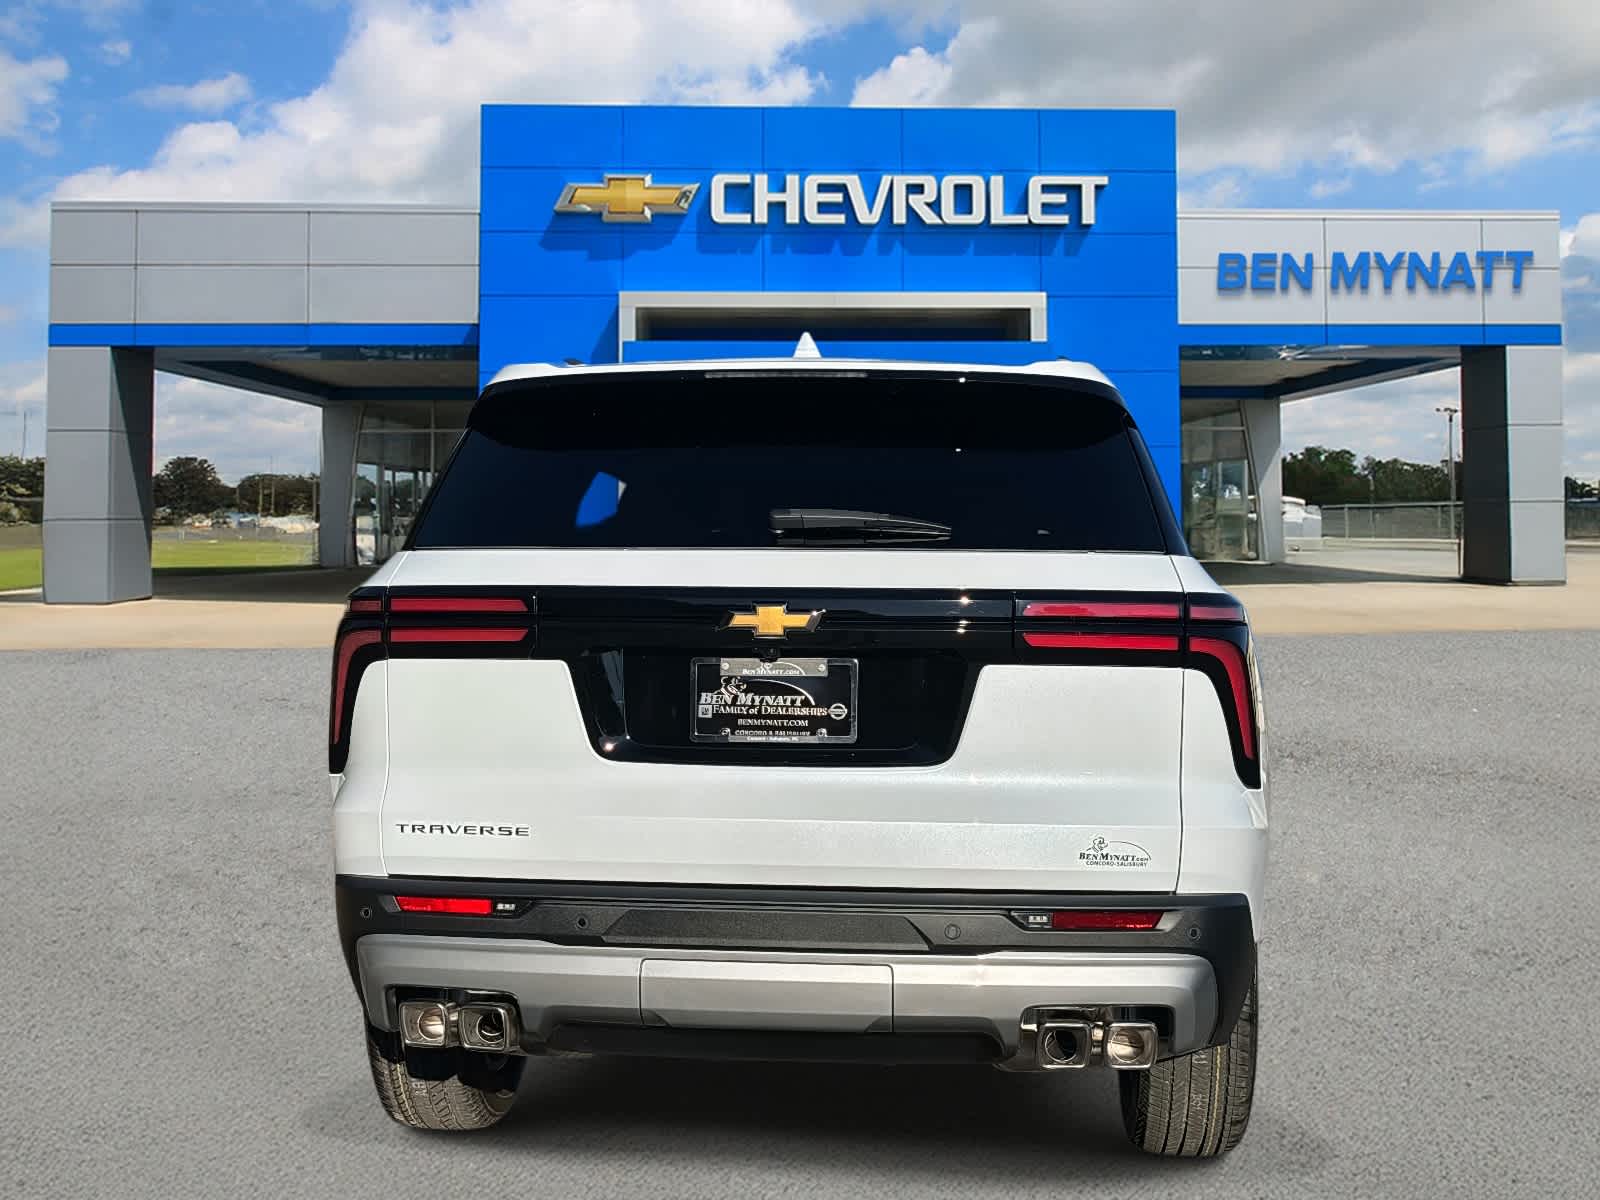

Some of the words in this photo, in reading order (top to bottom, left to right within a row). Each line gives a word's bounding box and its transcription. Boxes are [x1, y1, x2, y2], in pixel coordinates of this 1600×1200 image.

[711, 173, 1109, 225] CHEVROLET
[1217, 252, 1313, 290] BEN
[1330, 251, 1534, 290] MYNATT
[700, 692, 733, 704] BEN
[736, 693, 805, 706] MYNATT
[712, 705, 747, 714] FAMILY
[737, 719, 809, 727] BENMYNATT.COM
[395, 823, 530, 837] TRAVERSE
